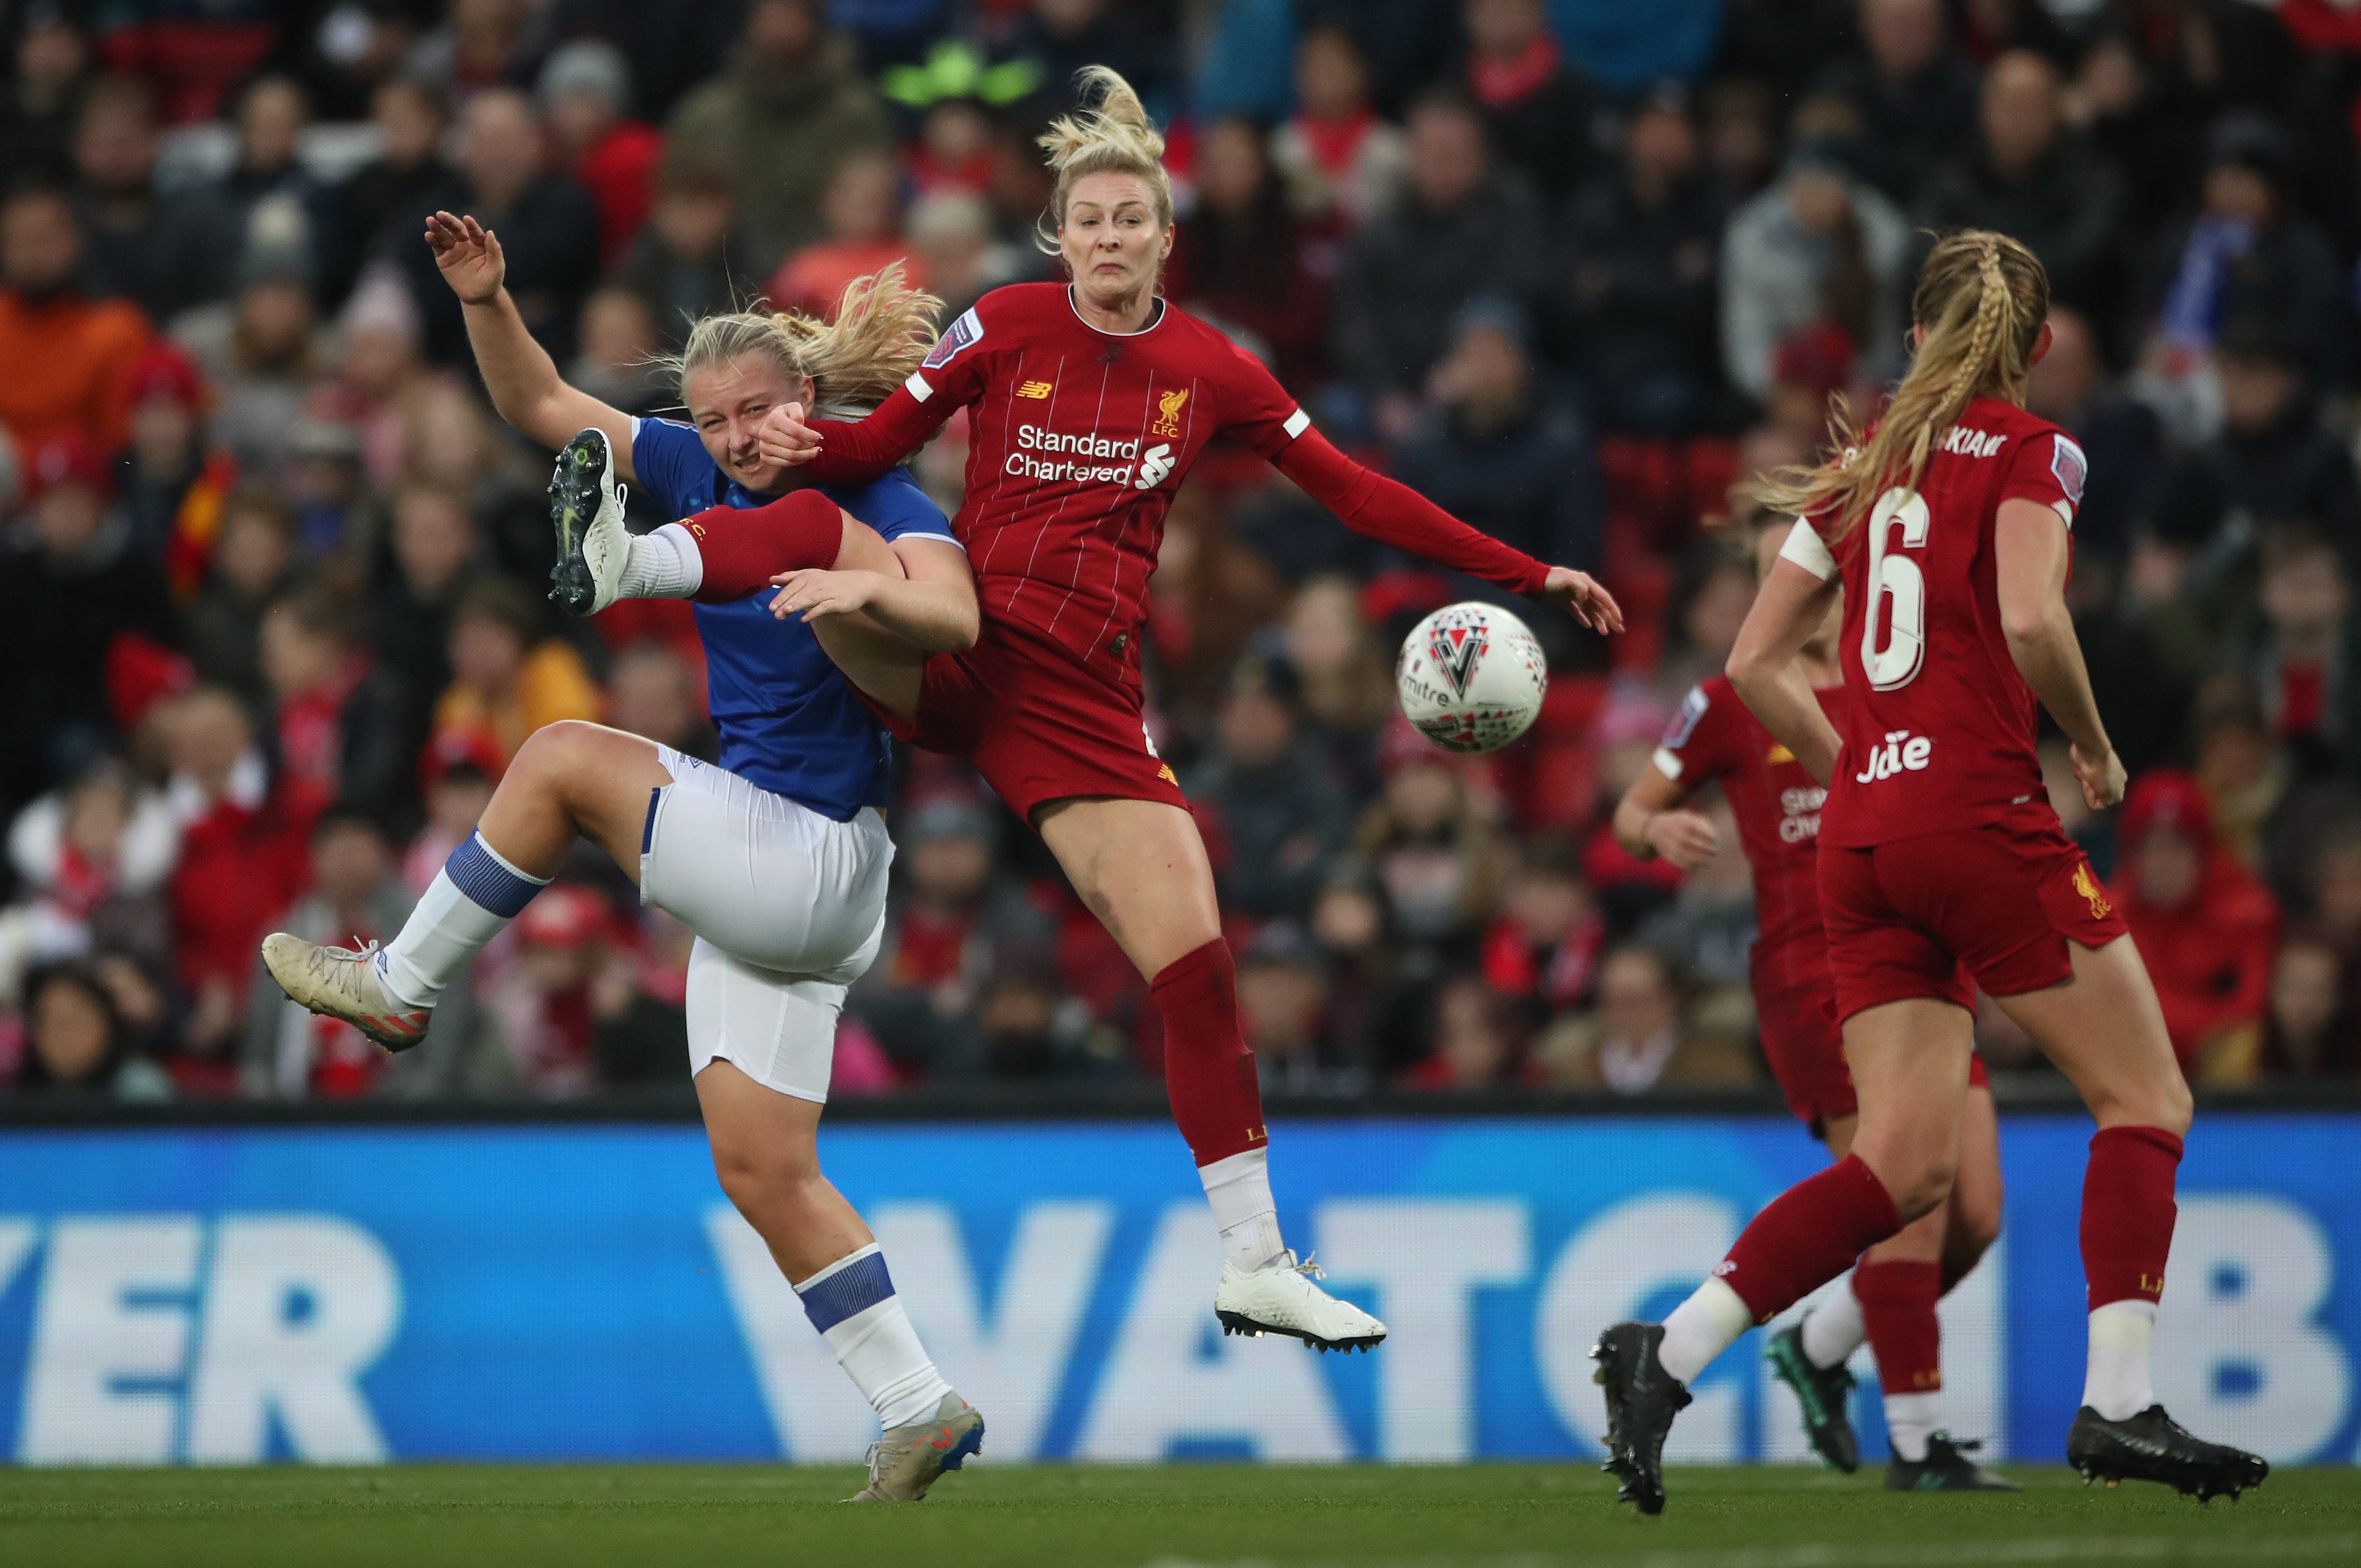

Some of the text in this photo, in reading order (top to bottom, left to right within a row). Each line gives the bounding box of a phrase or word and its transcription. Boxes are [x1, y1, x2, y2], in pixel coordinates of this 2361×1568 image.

[1017, 424, 1139, 460] Standard
[1005, 453, 1132, 485] Chartered
[1860, 486, 1930, 691] 6
[1404, 676, 1450, 707] mitre
[705, 1189, 2005, 1468] WATCH
[2151, 1192, 2361, 1468] B
